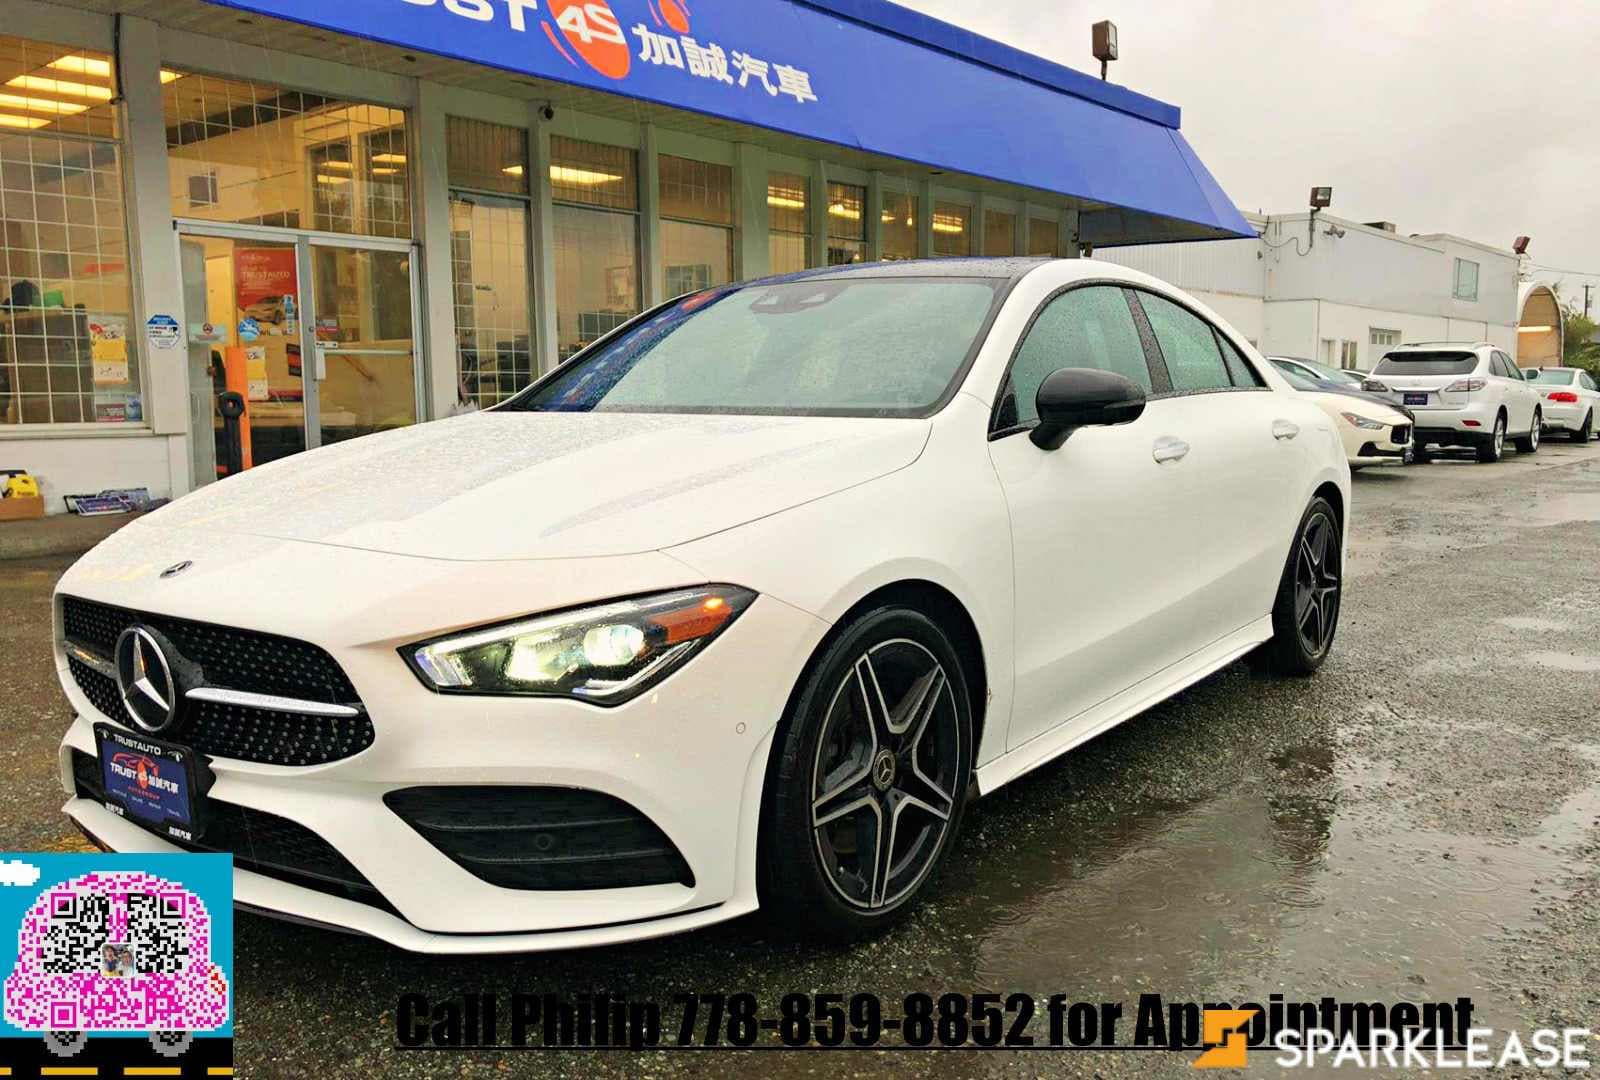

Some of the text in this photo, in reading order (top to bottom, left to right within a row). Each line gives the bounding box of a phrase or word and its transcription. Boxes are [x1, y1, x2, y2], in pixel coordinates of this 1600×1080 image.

[400, 0, 627, 44] ST 4S
[631, 22, 818, 103] 加誠汽車
[113, 734, 161, 756] TRUSTAUTO
[110, 762, 137, 781] TRUST
